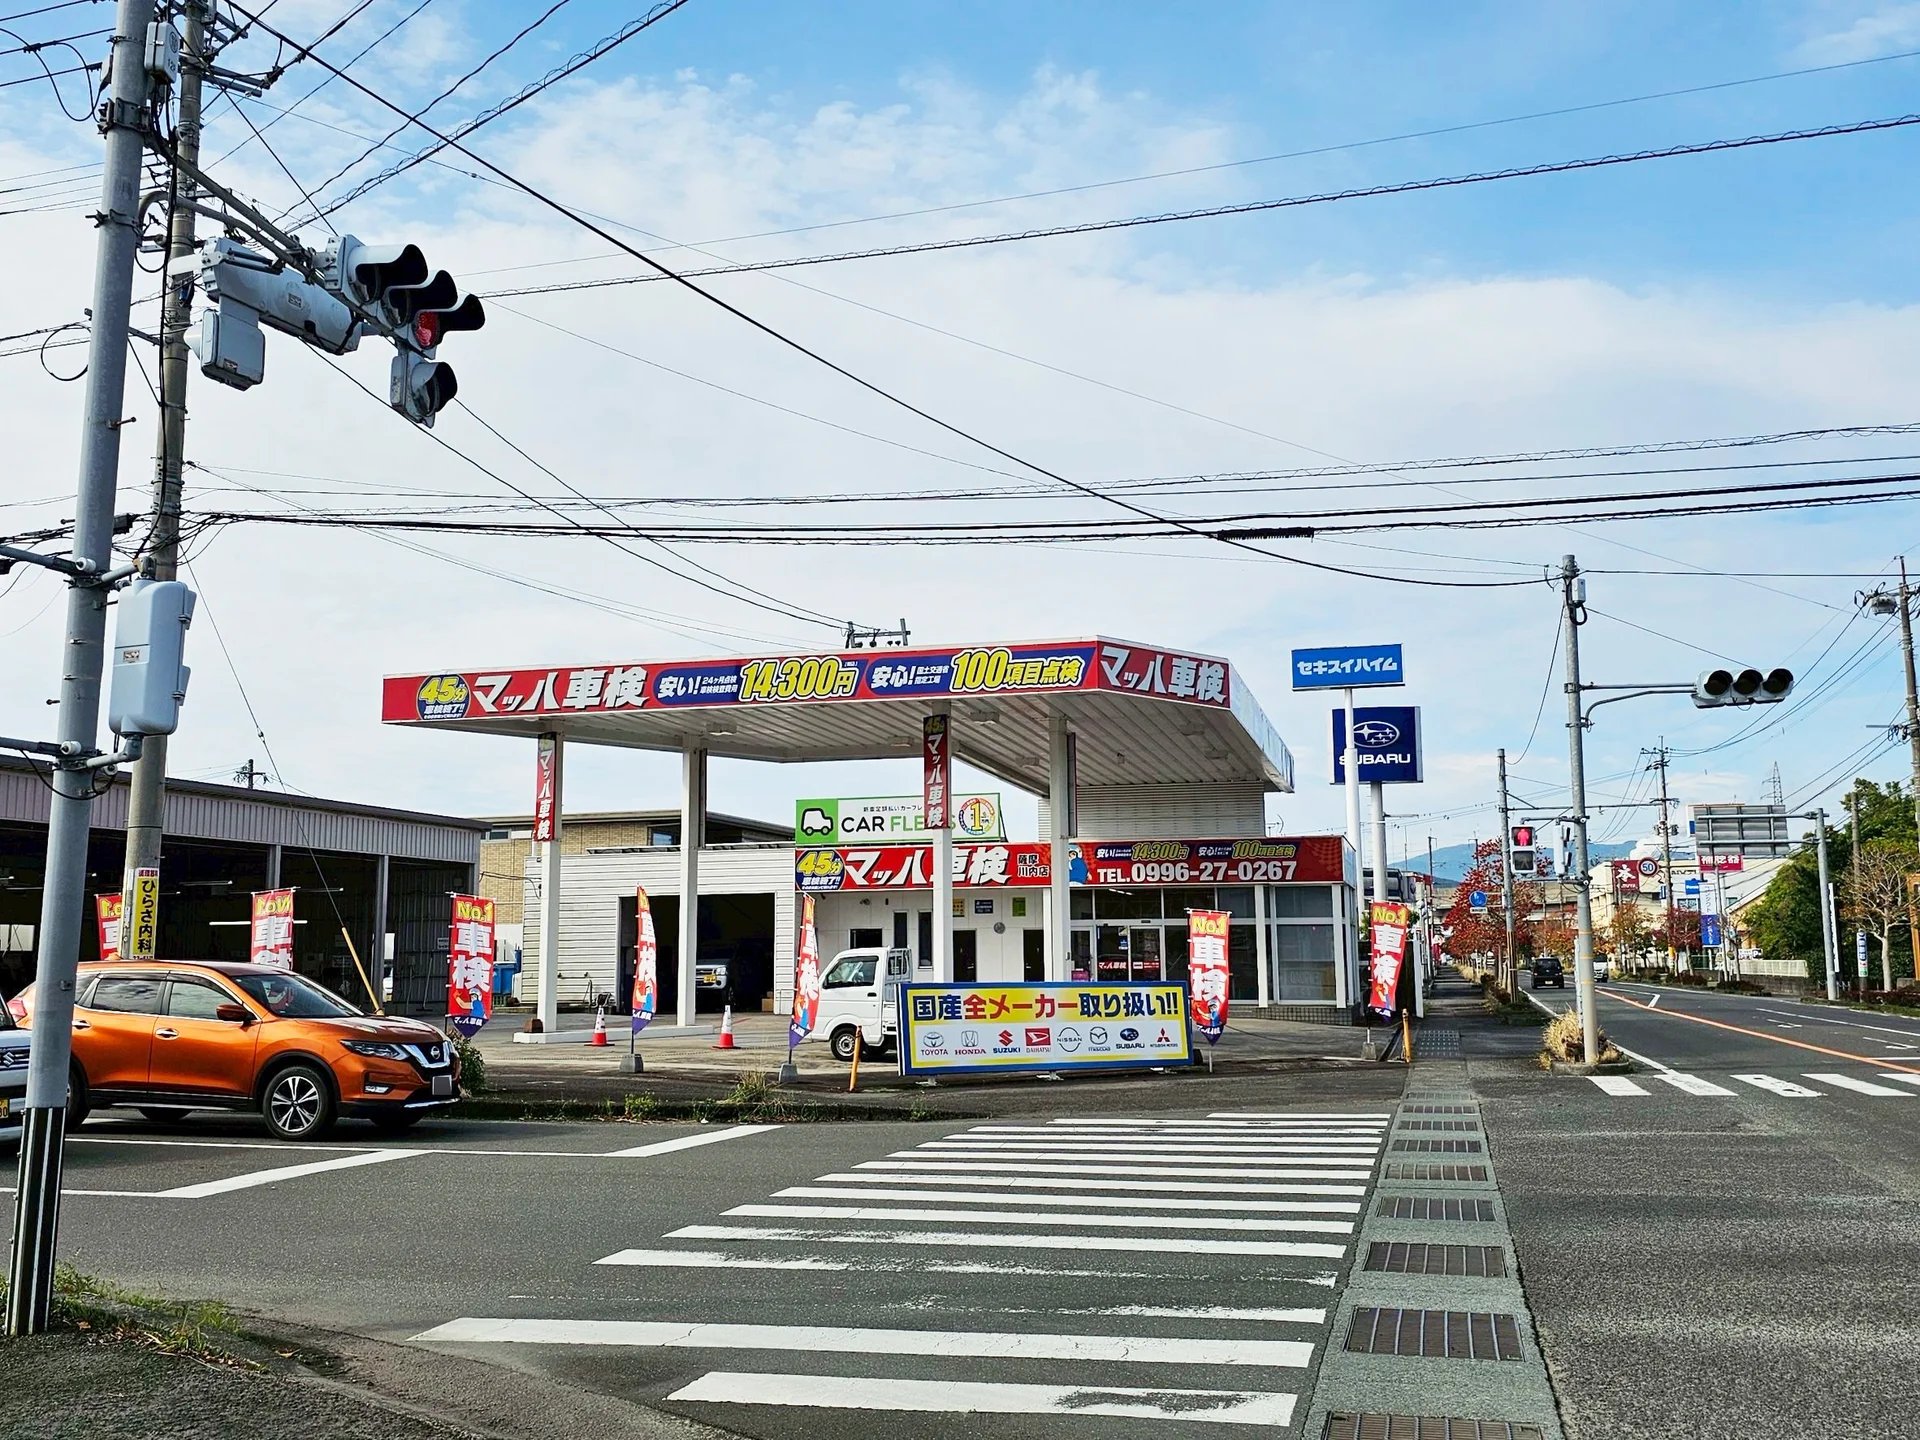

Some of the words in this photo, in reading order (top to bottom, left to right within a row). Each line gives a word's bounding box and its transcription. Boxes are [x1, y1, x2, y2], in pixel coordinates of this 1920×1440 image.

[740, 657, 858, 700] 14,300円
[952, 648, 1084, 690] 100項目点検
[1100, 645, 1227, 704] マッハ車検
[1297, 657, 1398, 676] セキスイハイム
[419, 677, 468, 704] 45分
[472, 666, 650, 713] マッハ車検
[658, 676, 701, 698] 安い!
[537, 749, 553, 840] マッハ車検
[927, 733, 944, 828] マッハ車検
[841, 815, 885, 834] CAR
[890, 815, 956, 833] FLES
[797, 851, 843, 876] 45分
[1017, 865, 1049, 877] 川内店
[1642, 863, 1654, 872] 50
[137, 880, 155, 953] ひらさ内科
[456, 900, 493, 924] No.1
[1191, 914, 1227, 936] No.1
[1372, 904, 1407, 926] No.1
[452, 921, 492, 993] 車検
[1373, 923, 1405, 987] 車検
[1191, 935, 1228, 1004] 車検
[912, 991, 1179, 1021] 国産全メーカー取り扱い!!
[920, 1048, 949, 1056] TOYOTA
